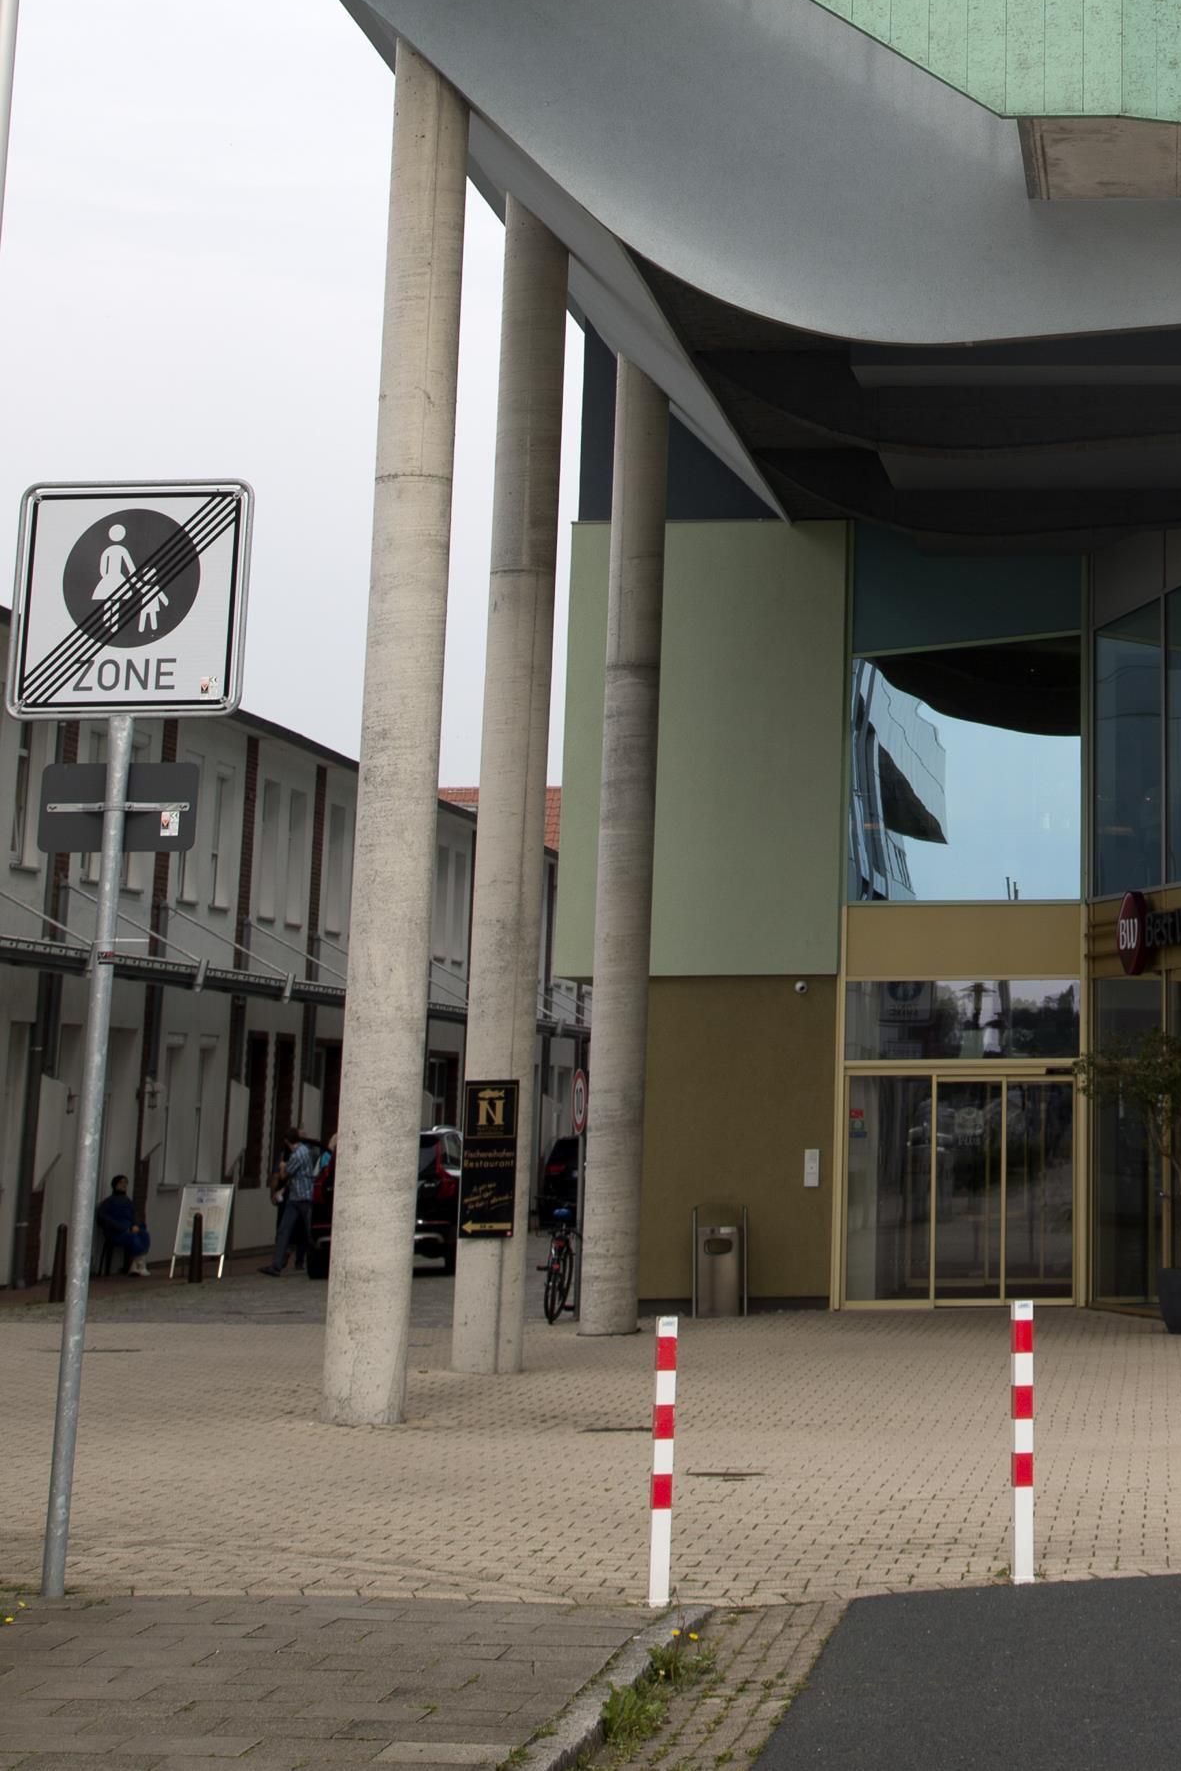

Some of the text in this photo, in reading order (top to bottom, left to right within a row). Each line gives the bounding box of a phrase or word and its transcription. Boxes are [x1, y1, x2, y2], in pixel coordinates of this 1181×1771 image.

[72, 657, 178, 692] ZONE
[1119, 918, 1138, 950] BW
[1145, 914, 1173, 948] Best
[463, 1159, 514, 1169] Restaurant
